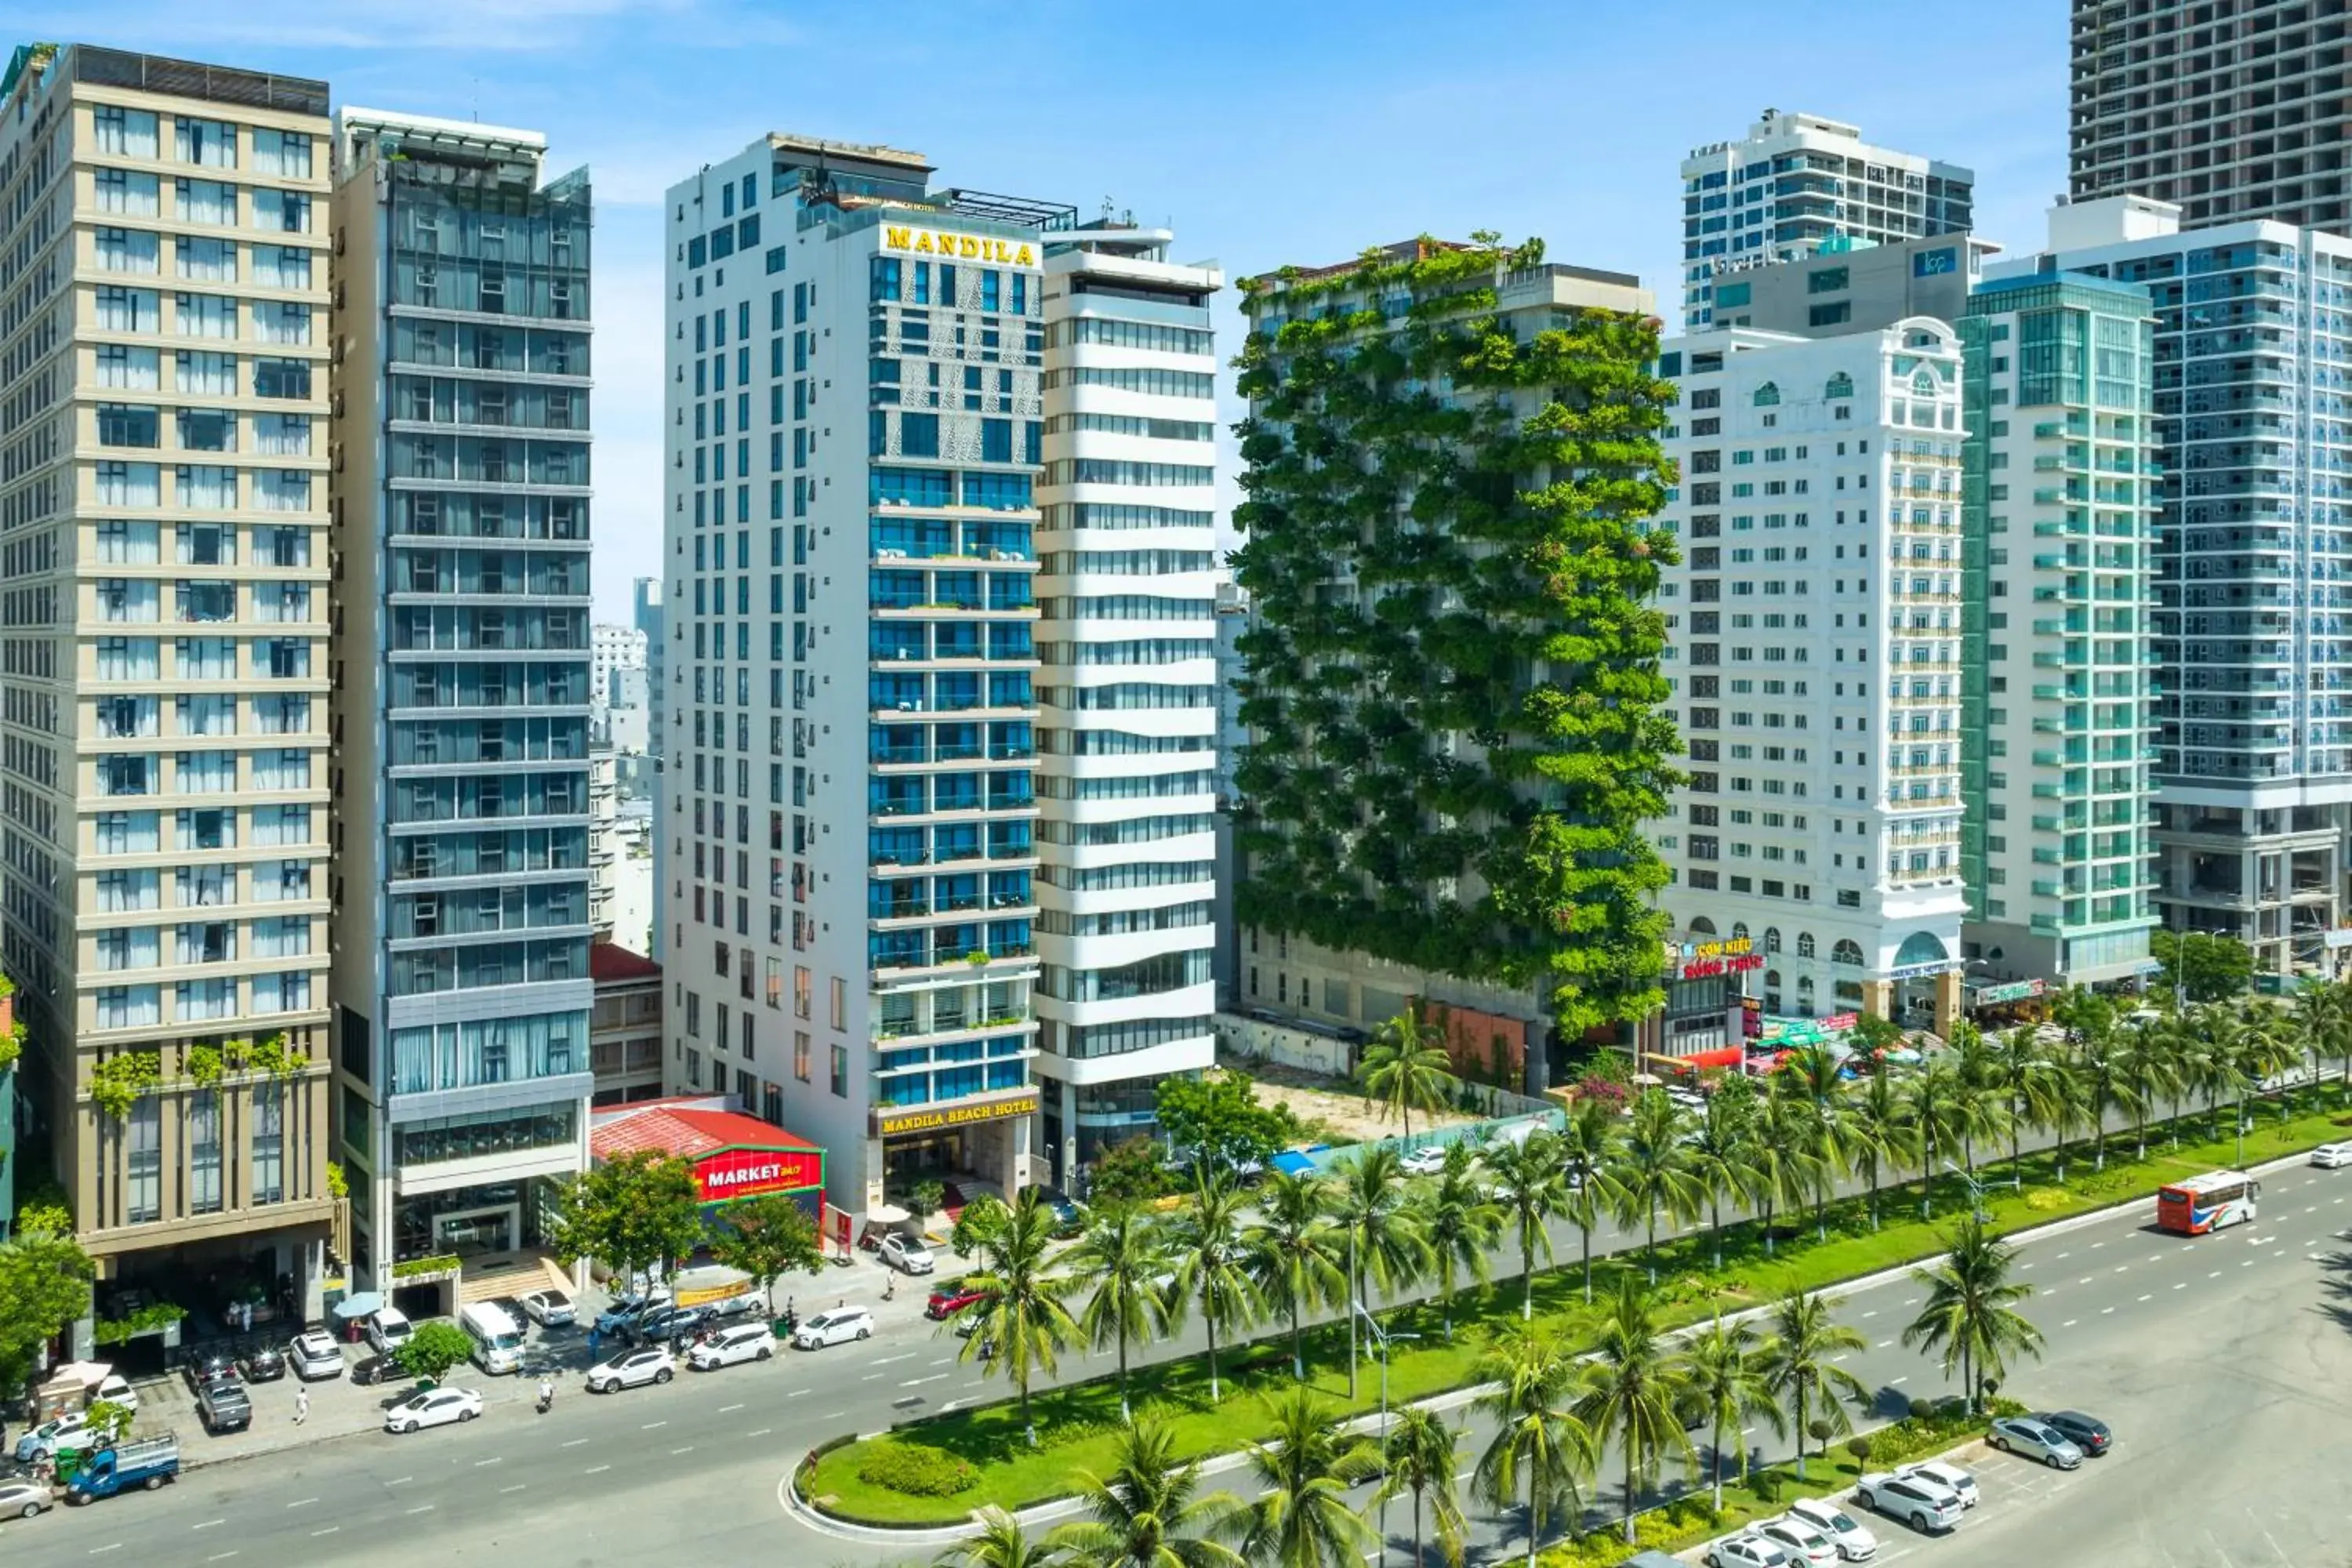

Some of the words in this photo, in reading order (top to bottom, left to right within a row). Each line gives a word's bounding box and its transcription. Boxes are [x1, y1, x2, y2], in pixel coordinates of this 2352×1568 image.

[887, 225, 1034, 265] MANDILA
[883, 1112, 944, 1133] MANDILA
[948, 1105, 991, 1123] BEACH
[994, 1098, 1036, 1116] HOTEL
[708, 1163, 782, 1188] MARKET
